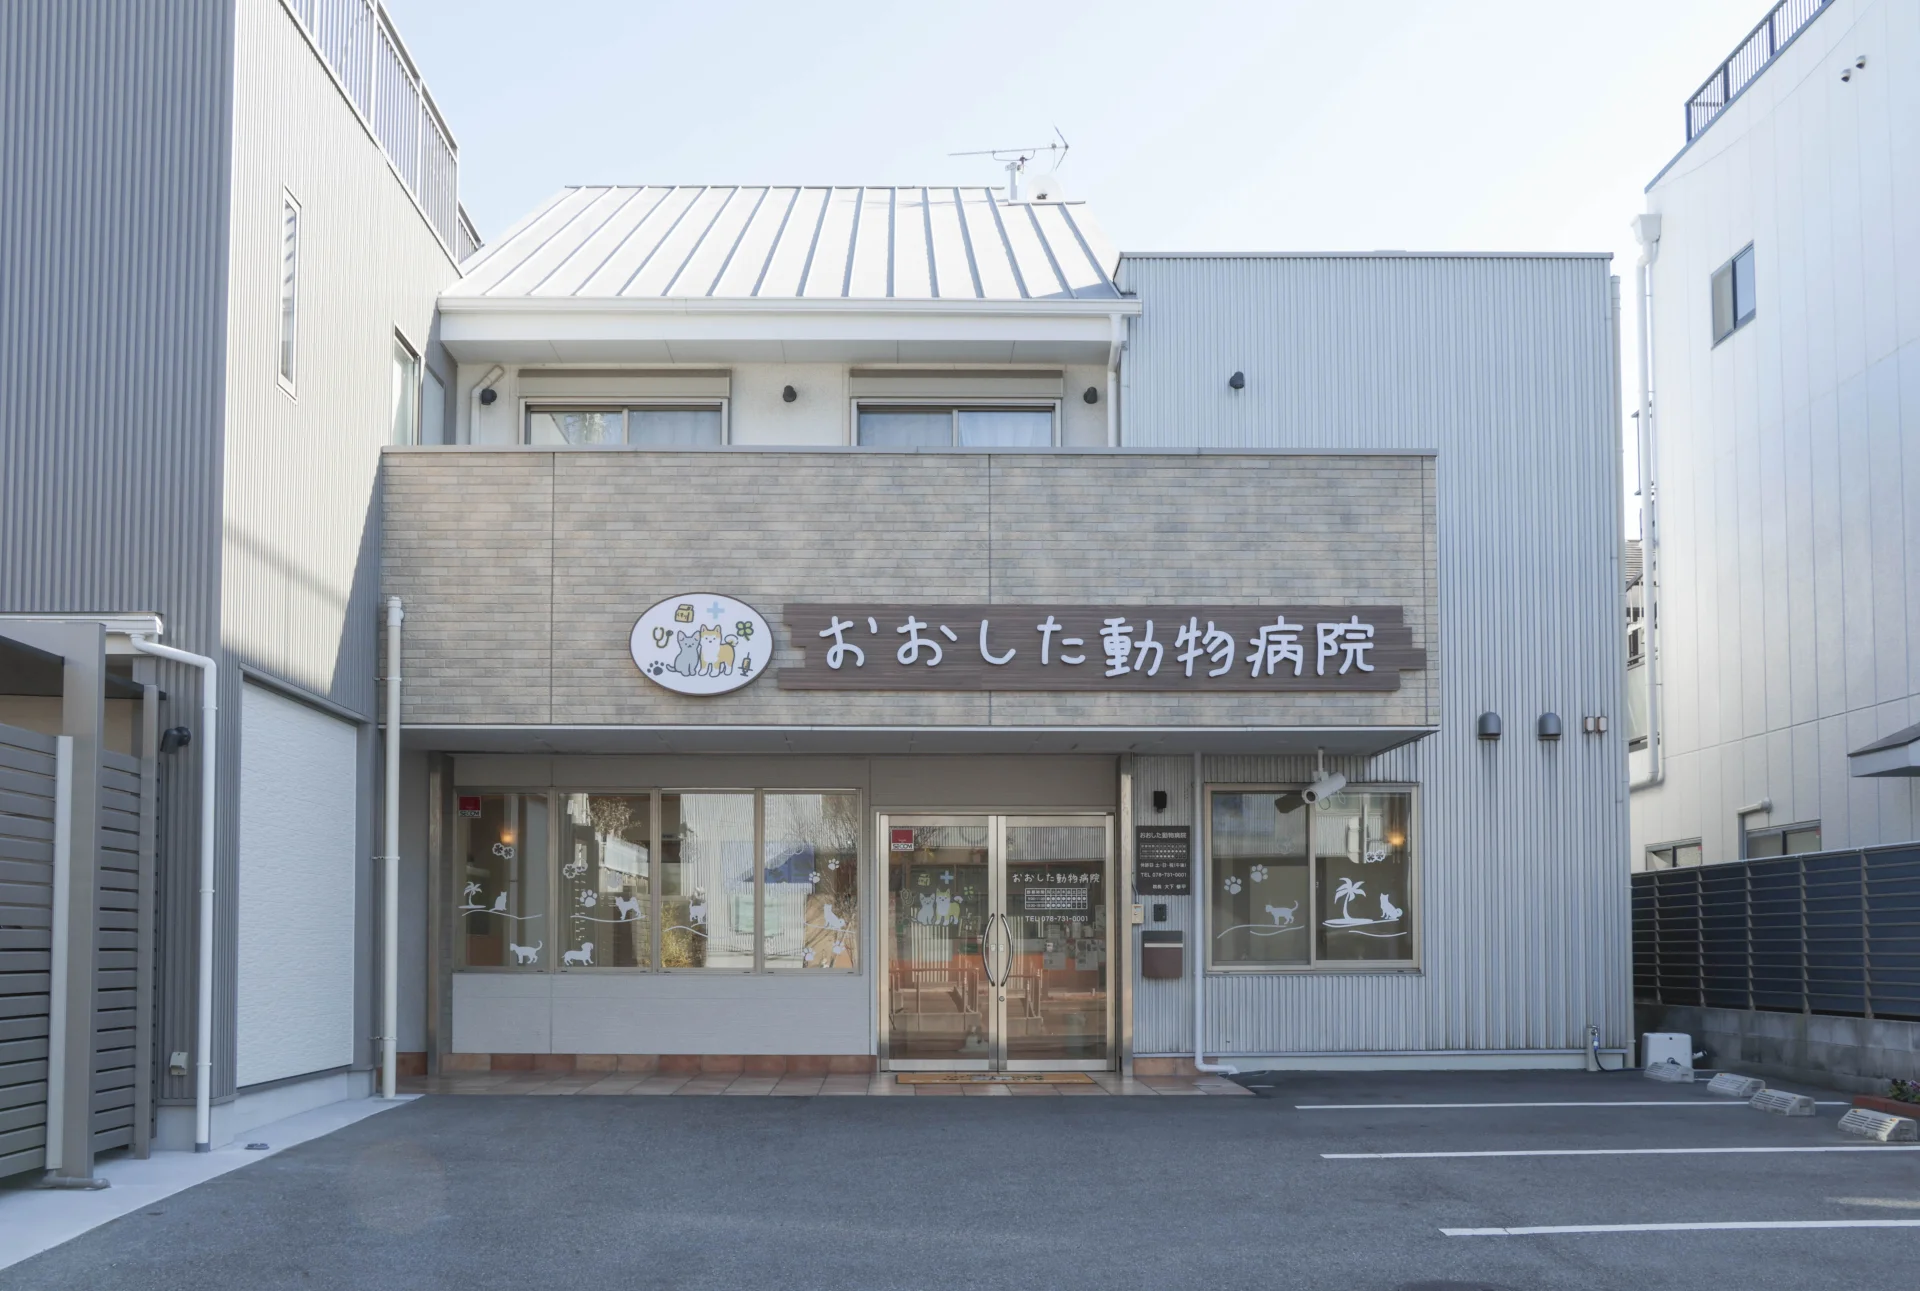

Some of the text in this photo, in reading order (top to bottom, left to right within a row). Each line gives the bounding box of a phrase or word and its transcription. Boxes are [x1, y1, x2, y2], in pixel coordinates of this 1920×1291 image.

[819, 615, 1375, 677] おおした動物病院
[1012, 872, 1101, 884] おおした動物病院
